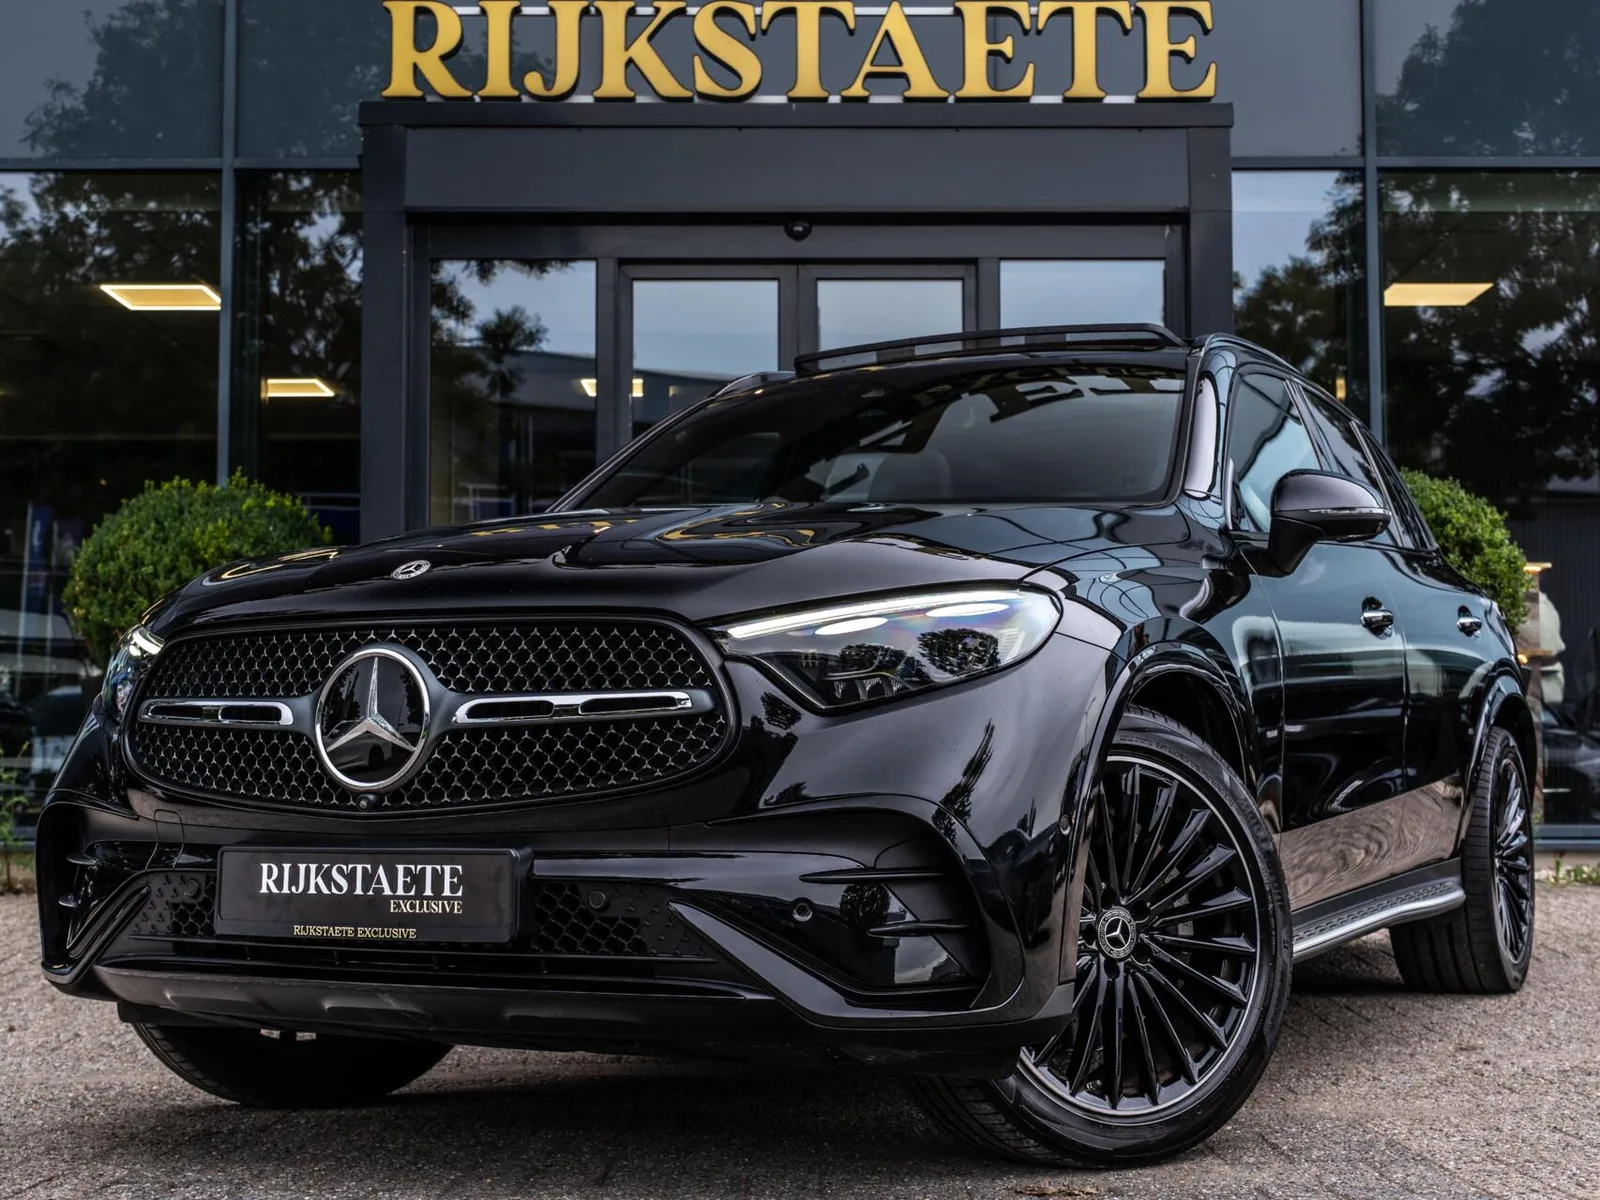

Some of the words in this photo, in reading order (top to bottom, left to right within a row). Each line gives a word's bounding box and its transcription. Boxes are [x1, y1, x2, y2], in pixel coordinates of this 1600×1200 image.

[381, 0, 1218, 102] RIJKSTAETE
[259, 863, 463, 896] RIJKSTAETE
[390, 900, 463, 914] EXCLUSIVE
[293, 924, 355, 937] RIJKSTAETE
[357, 927, 417, 939] EXCLUSIVE
